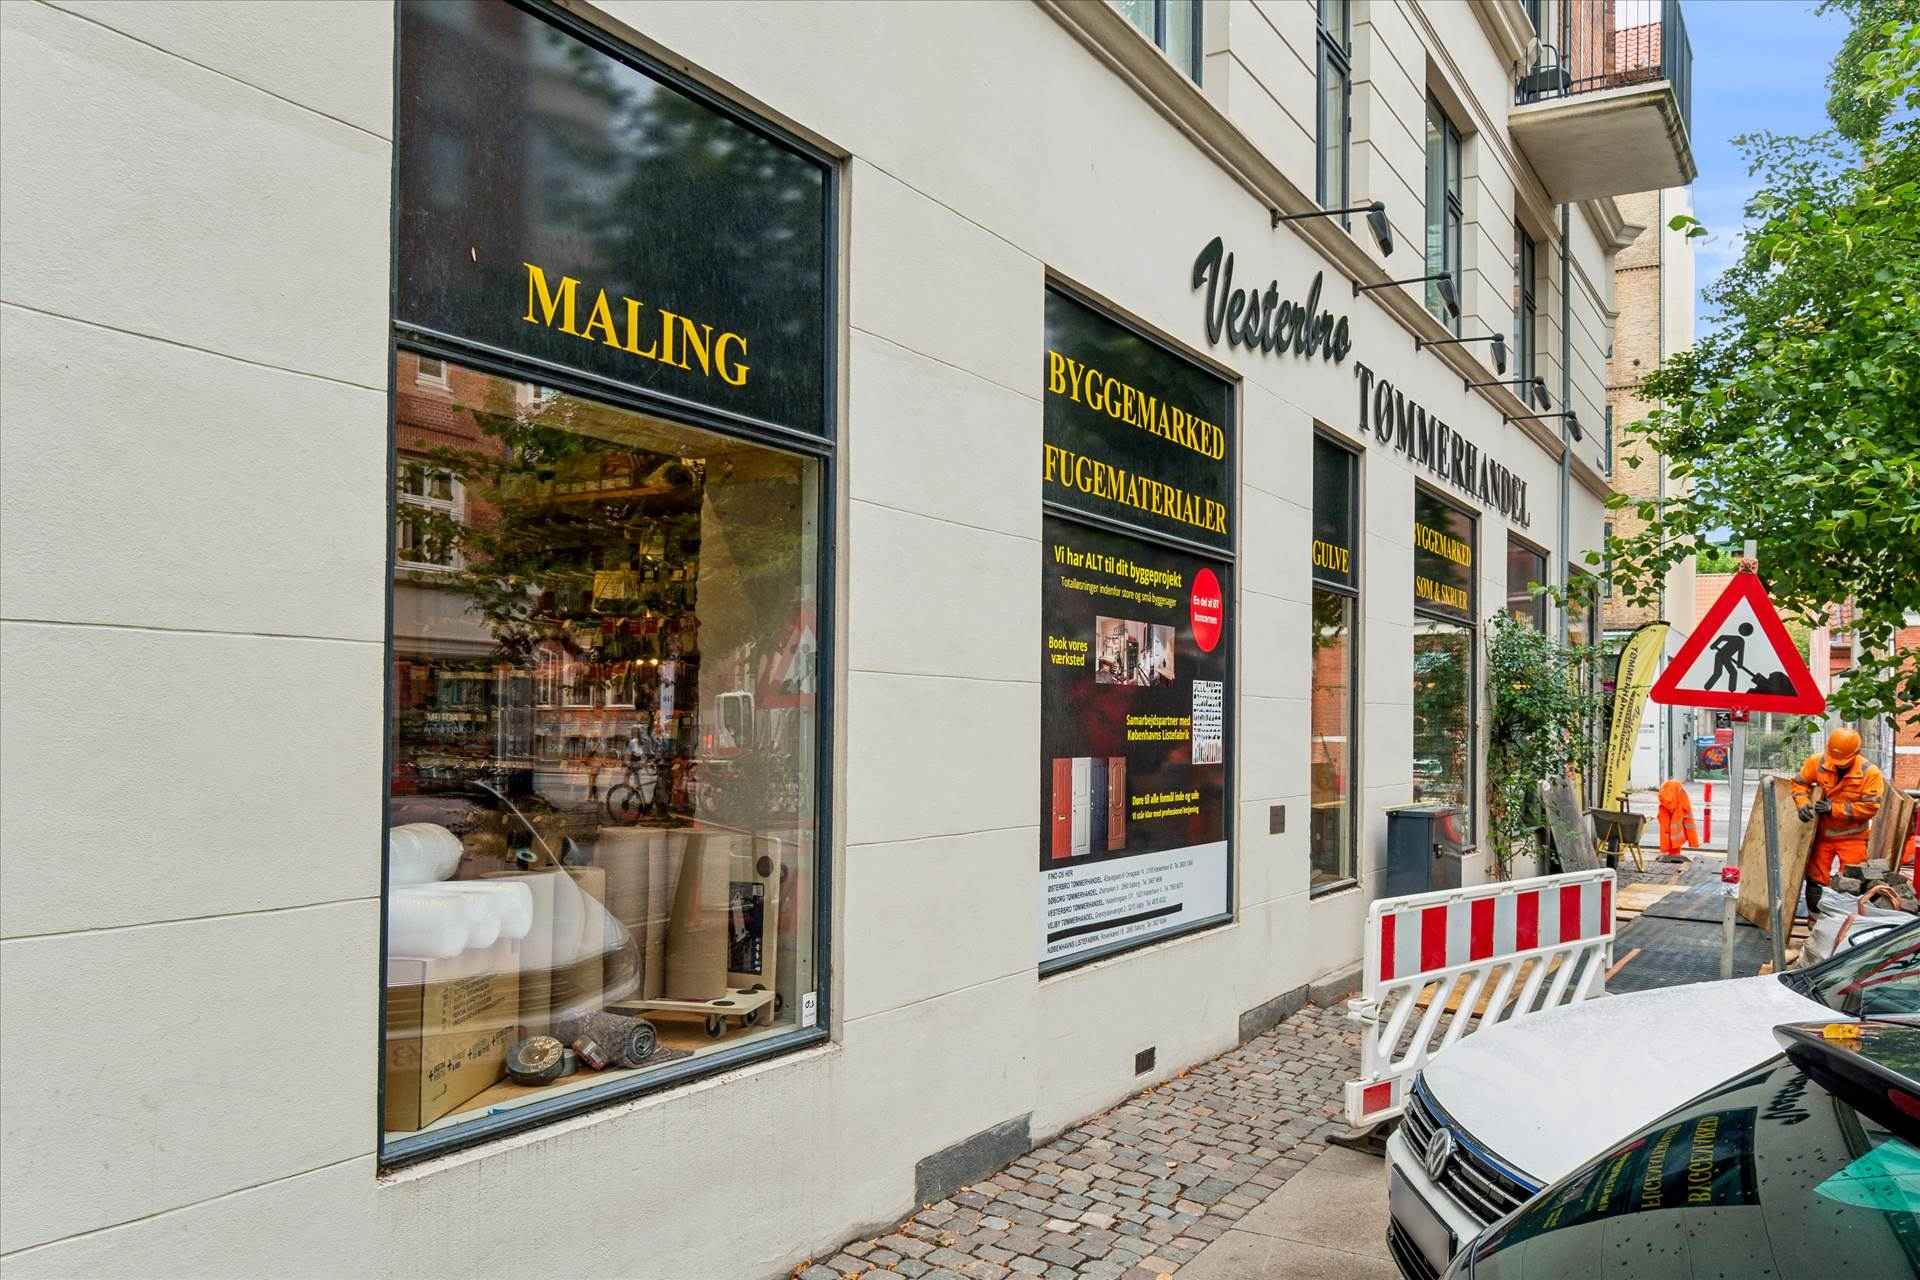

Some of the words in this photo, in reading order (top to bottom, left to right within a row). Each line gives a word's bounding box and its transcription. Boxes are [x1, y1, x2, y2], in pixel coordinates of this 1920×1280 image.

[1192, 236, 1352, 362] Vesterbro
[523, 262, 750, 386] MALING
[1048, 351, 1225, 460] BYGGEMARKED
[1355, 360, 1531, 529] TØMMERHANDEL
[1044, 443, 1227, 534] FUGEMATERIALER
[1054, 544, 1064, 562] Vi
[1066, 548, 1084, 567] har
[1085, 552, 1103, 571] ALT
[1104, 556, 1114, 573] til
[1116, 559, 1128, 577] dit
[1130, 562, 1183, 589] byggeprojekt
[1312, 536, 1349, 574] GULVE
[1121, 588, 1134, 600] store
[1433, 581, 1440, 603] &
[1049, 635, 1067, 649] Book
[1068, 638, 1088, 652] vores
[1051, 653, 1085, 666] værksted
[1127, 728, 1161, 741] Københavns
